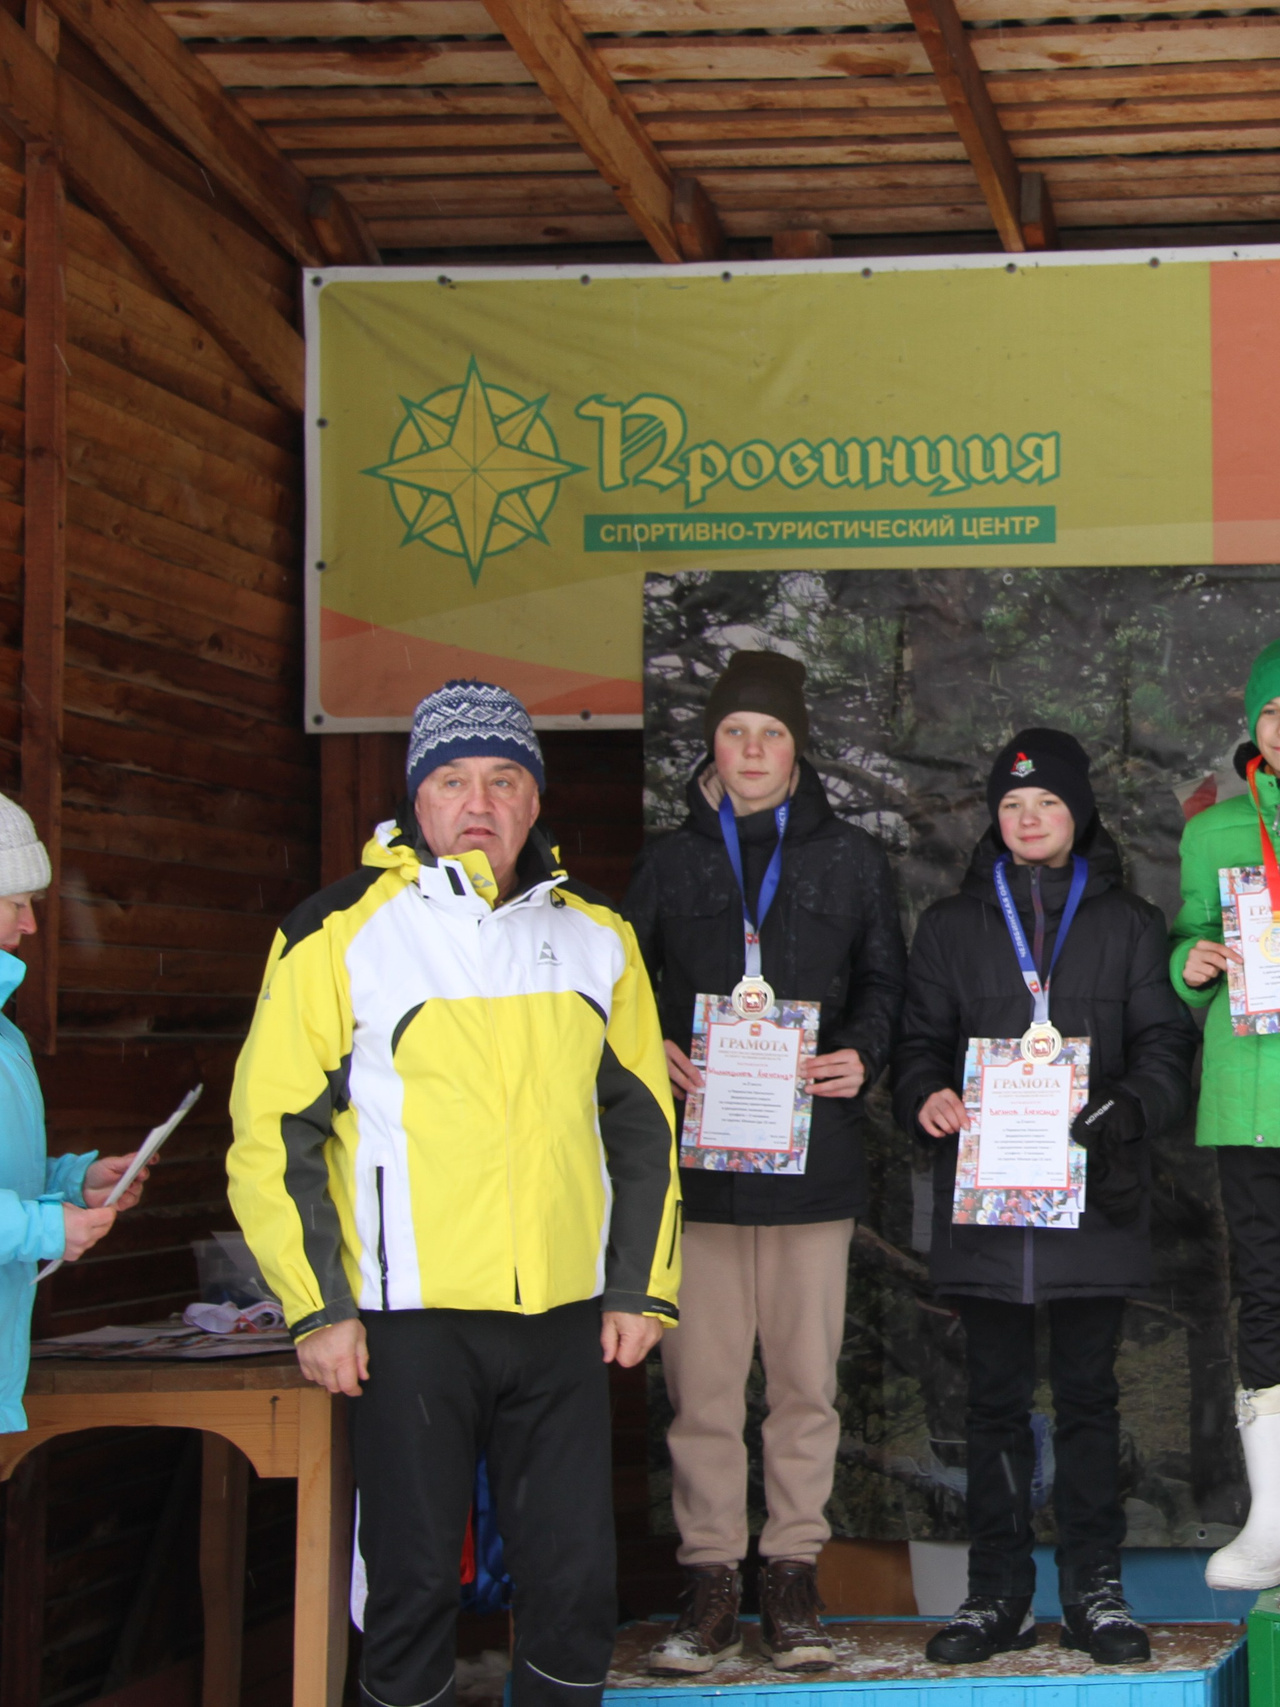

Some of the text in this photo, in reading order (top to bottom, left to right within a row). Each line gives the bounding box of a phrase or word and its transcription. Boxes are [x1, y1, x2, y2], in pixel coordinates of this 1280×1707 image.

[575, 391, 1061, 510] Провинция
[600, 514, 1041, 544] СПОРТИВНО-ТУРИСТИЧЕСКИЙ ЦЕНТР
[719, 1036, 789, 1052] ГРАМОТА
[993, 1078, 1061, 1090] ГРАМОТА
